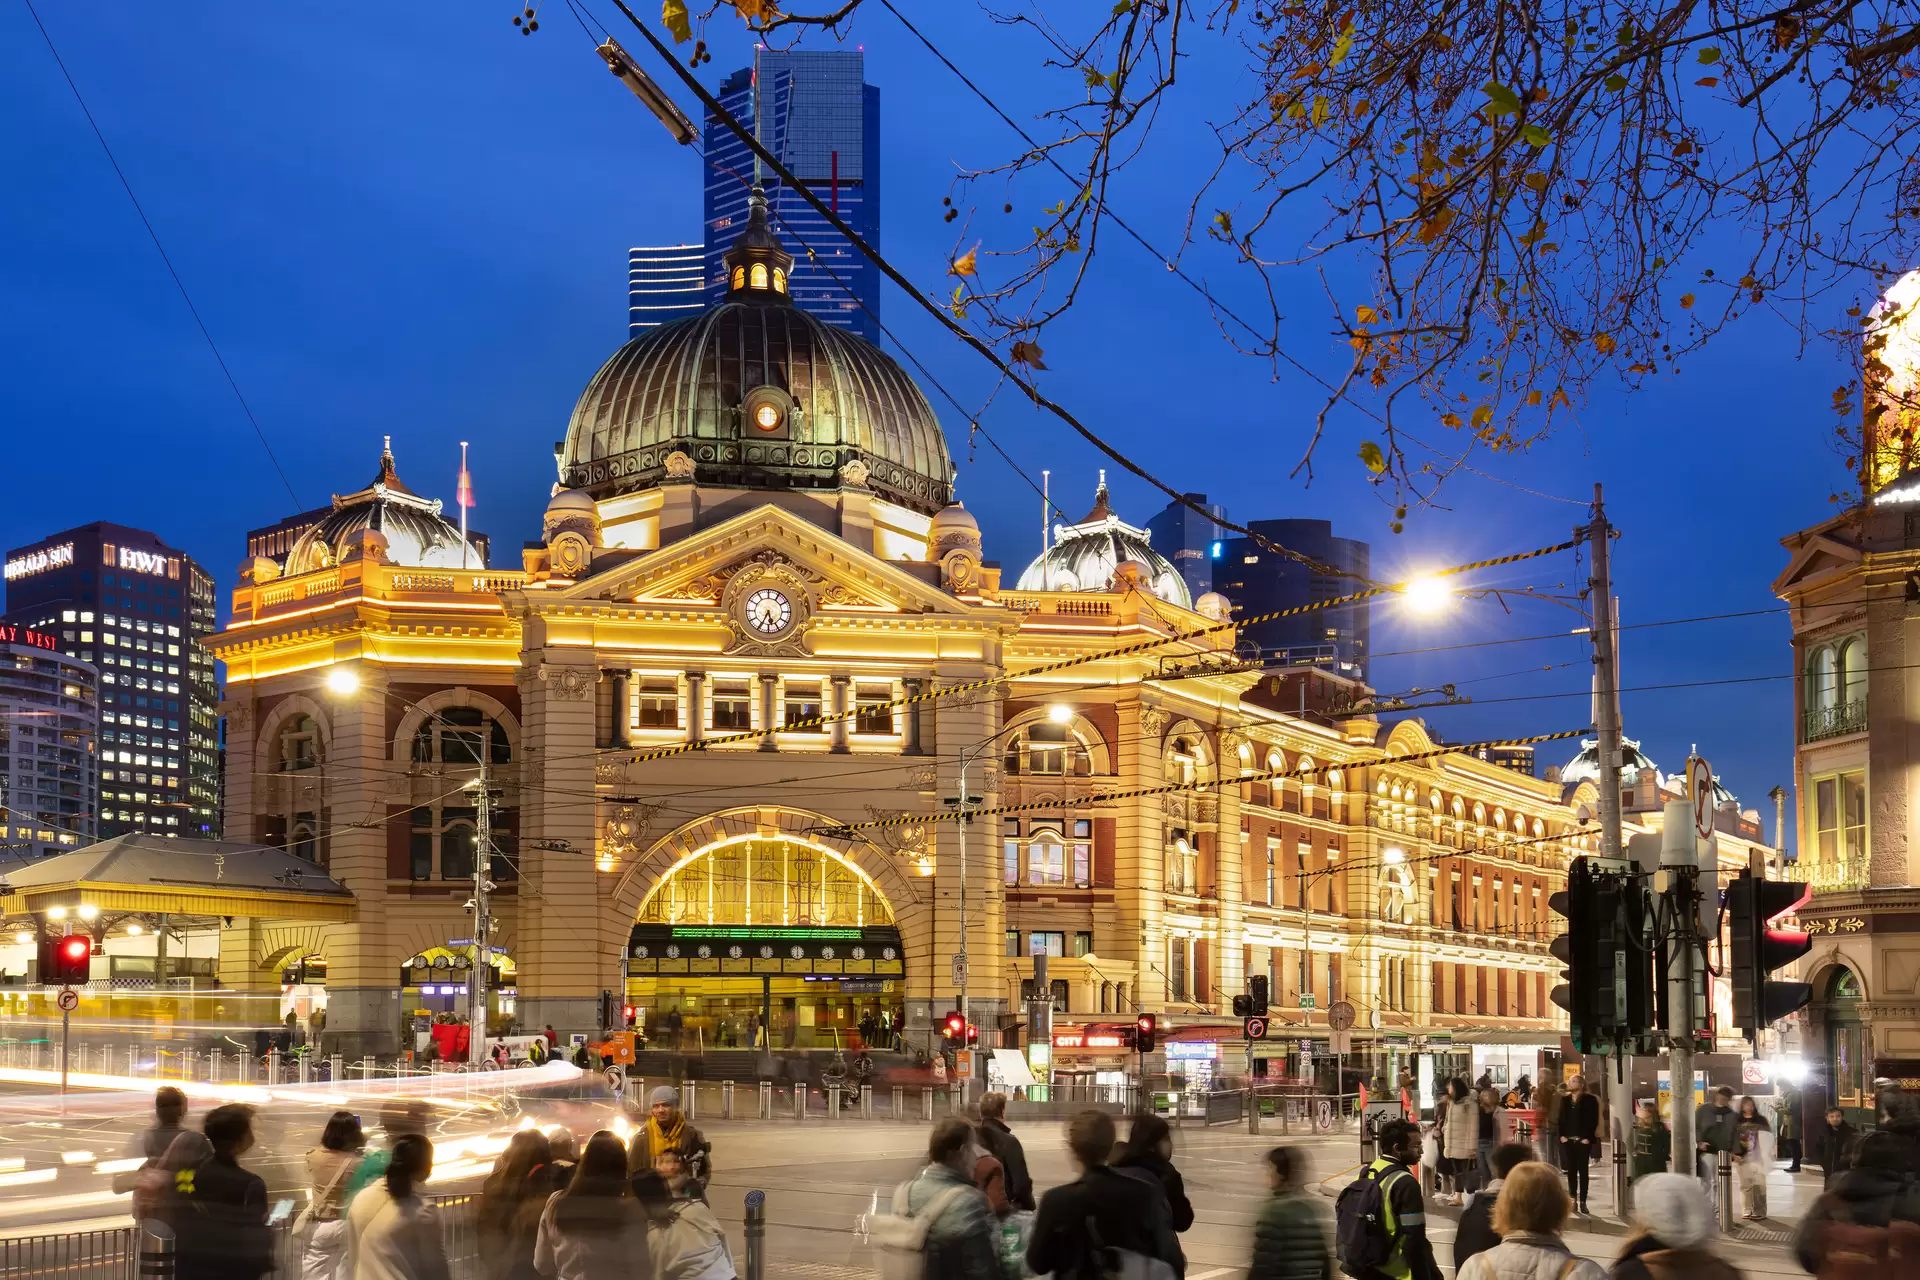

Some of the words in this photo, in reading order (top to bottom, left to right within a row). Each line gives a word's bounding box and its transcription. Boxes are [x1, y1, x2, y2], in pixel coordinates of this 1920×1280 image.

[4, 553, 48, 579] HERALD
[50, 546, 73, 566] SUN
[119, 546, 167, 575] HWT
[26, 630, 57, 651] WEST
[1056, 1036, 1083, 1047] CITY
